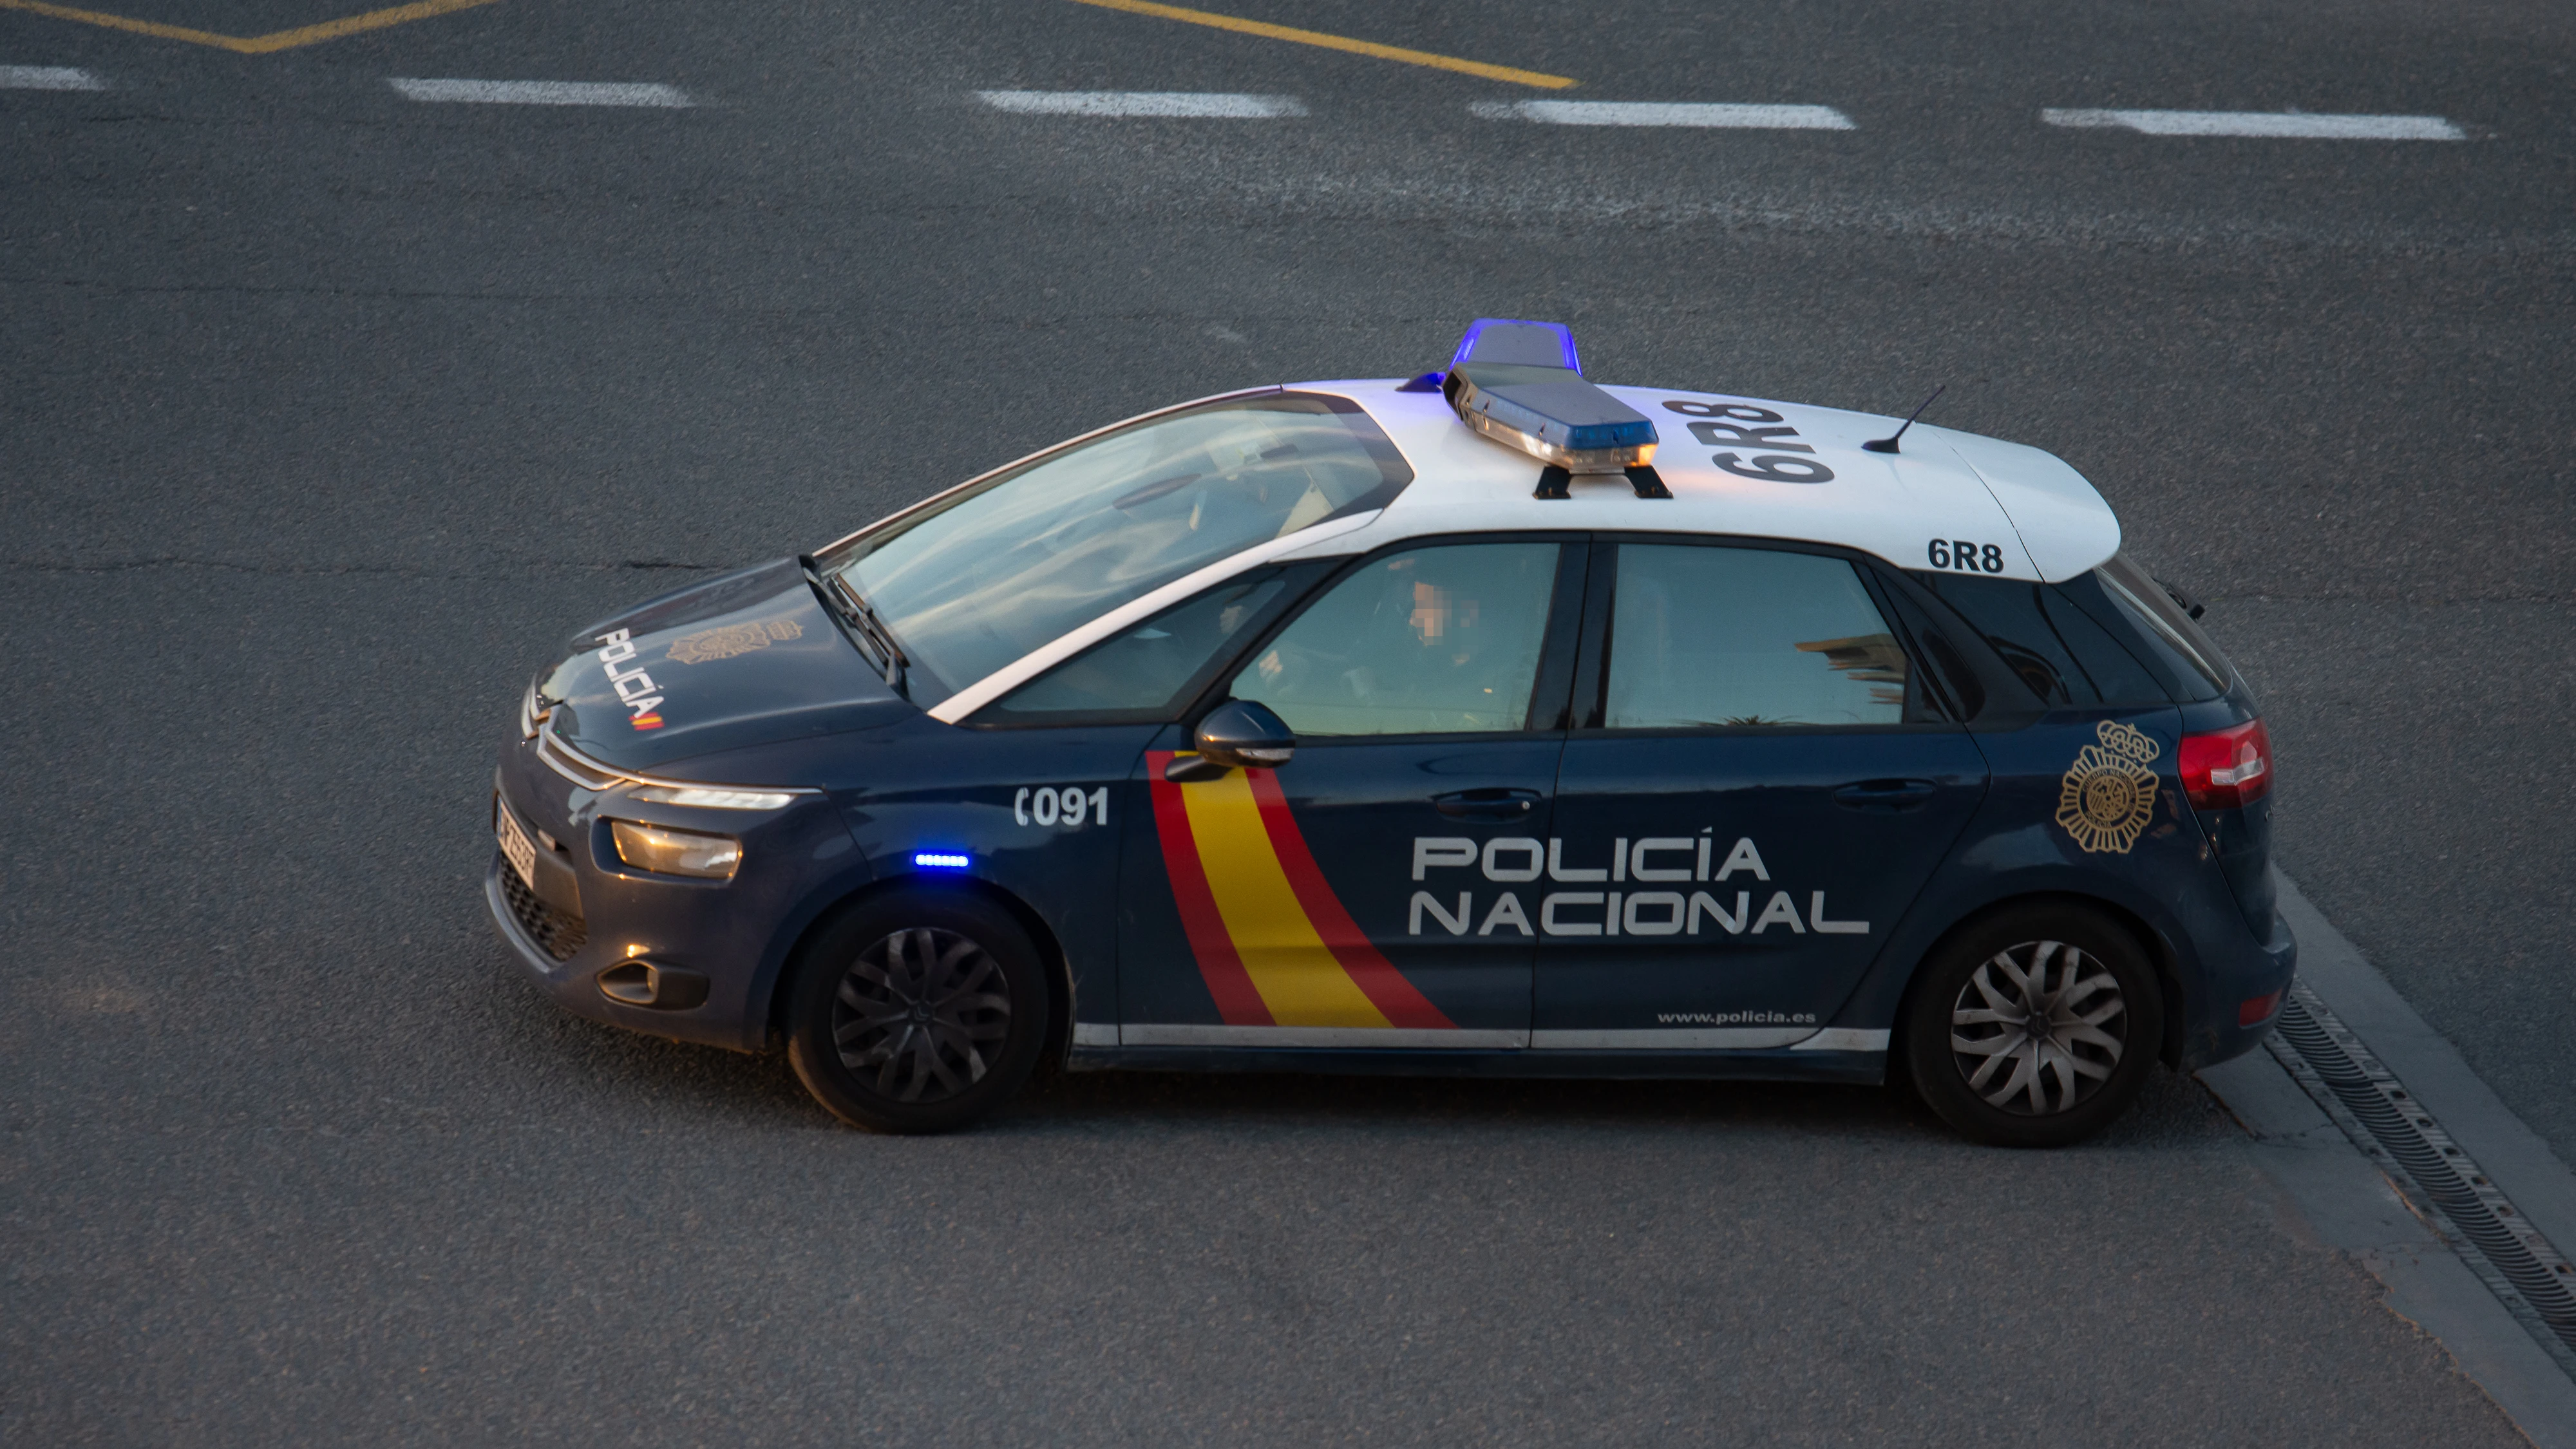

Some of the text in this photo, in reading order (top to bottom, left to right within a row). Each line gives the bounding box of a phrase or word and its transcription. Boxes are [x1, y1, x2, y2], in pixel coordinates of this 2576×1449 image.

[1662, 400, 1835, 484] 6R8
[1928, 538, 2004, 573] 6R8
[595, 627, 665, 719] POLICÍA
[1033, 787, 1108, 826] 091
[1412, 826, 1770, 882] POLICÍA
[1408, 891, 1870, 936] NACIONAL
[1658, 1010, 1816, 1025] www.policia.es
